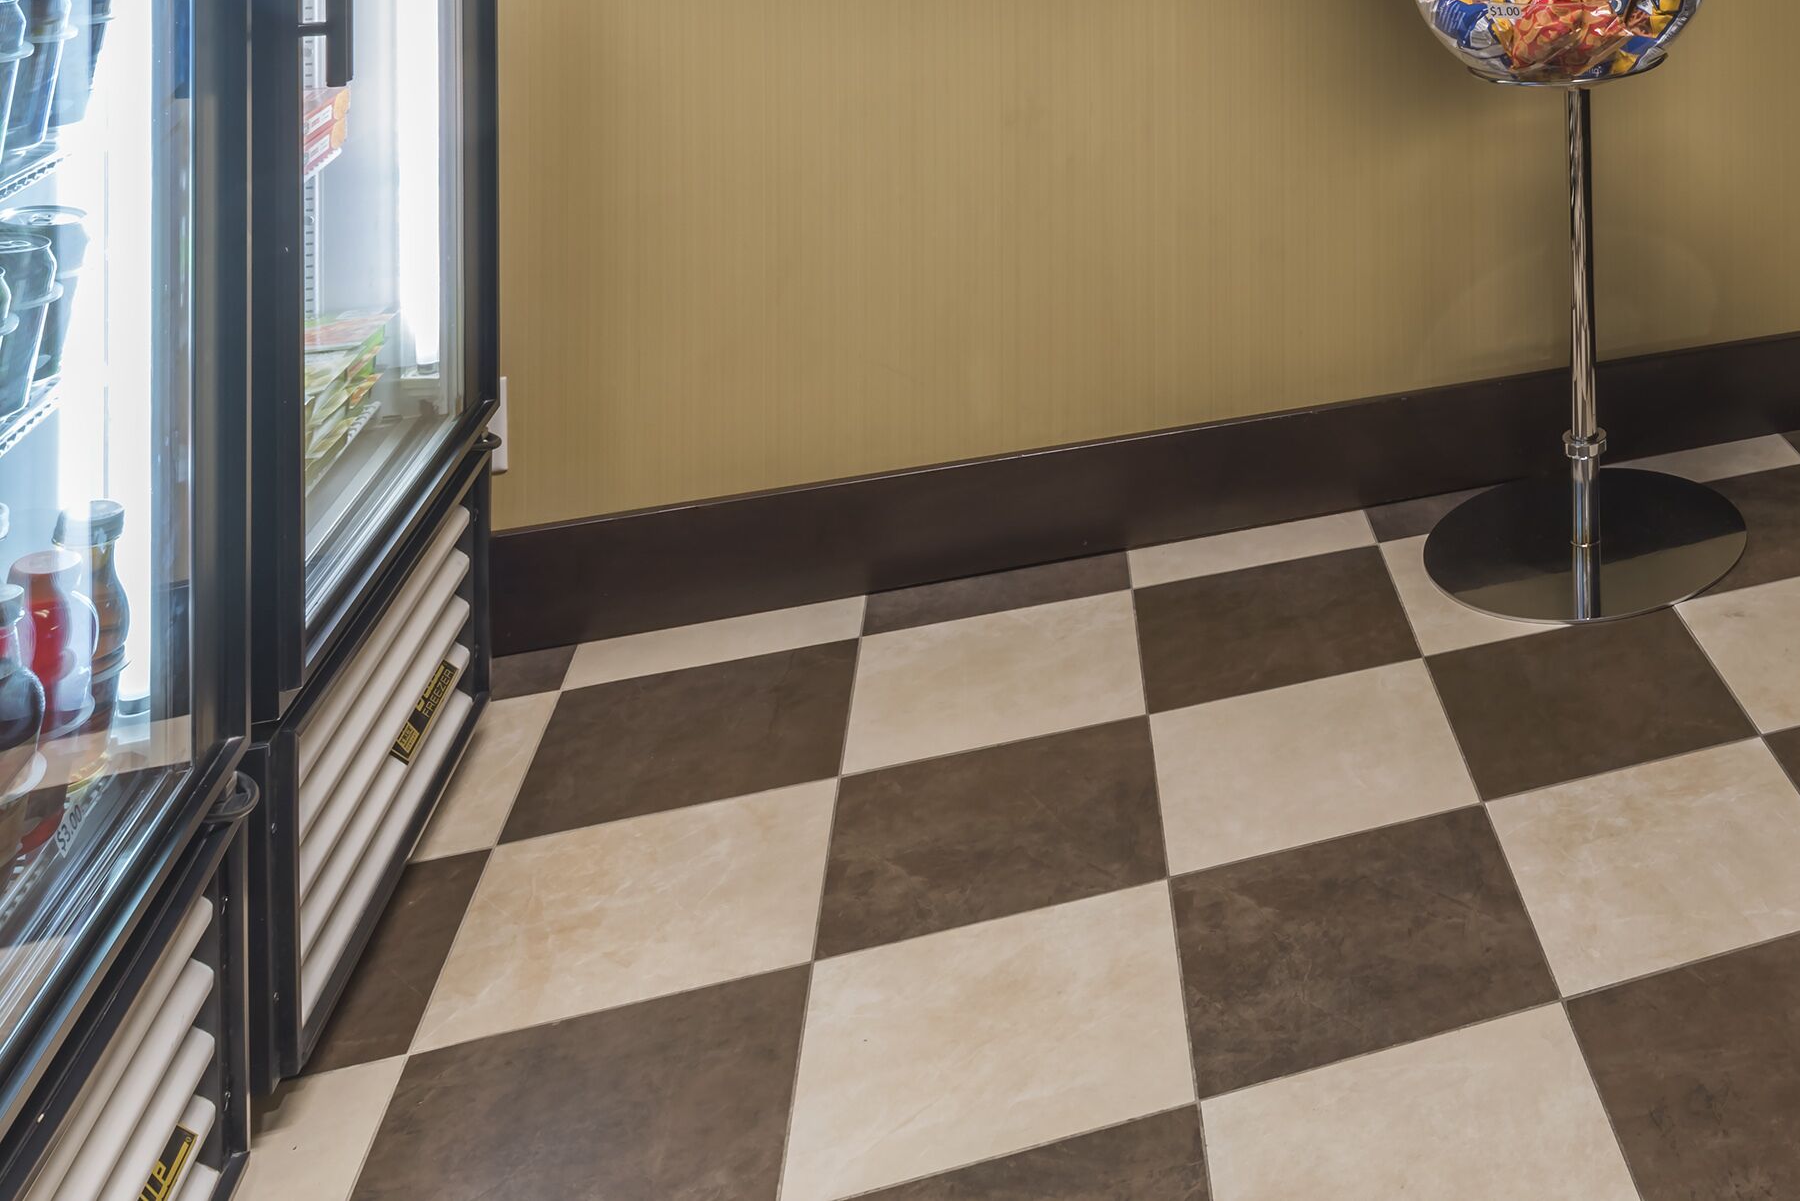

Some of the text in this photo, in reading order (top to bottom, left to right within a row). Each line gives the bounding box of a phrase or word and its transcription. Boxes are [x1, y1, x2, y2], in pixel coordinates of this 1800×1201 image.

[1490, 6, 1520, 16] $1.00
[422, 669, 452, 719] FREEZER
[57, 804, 83, 852] $3.00
